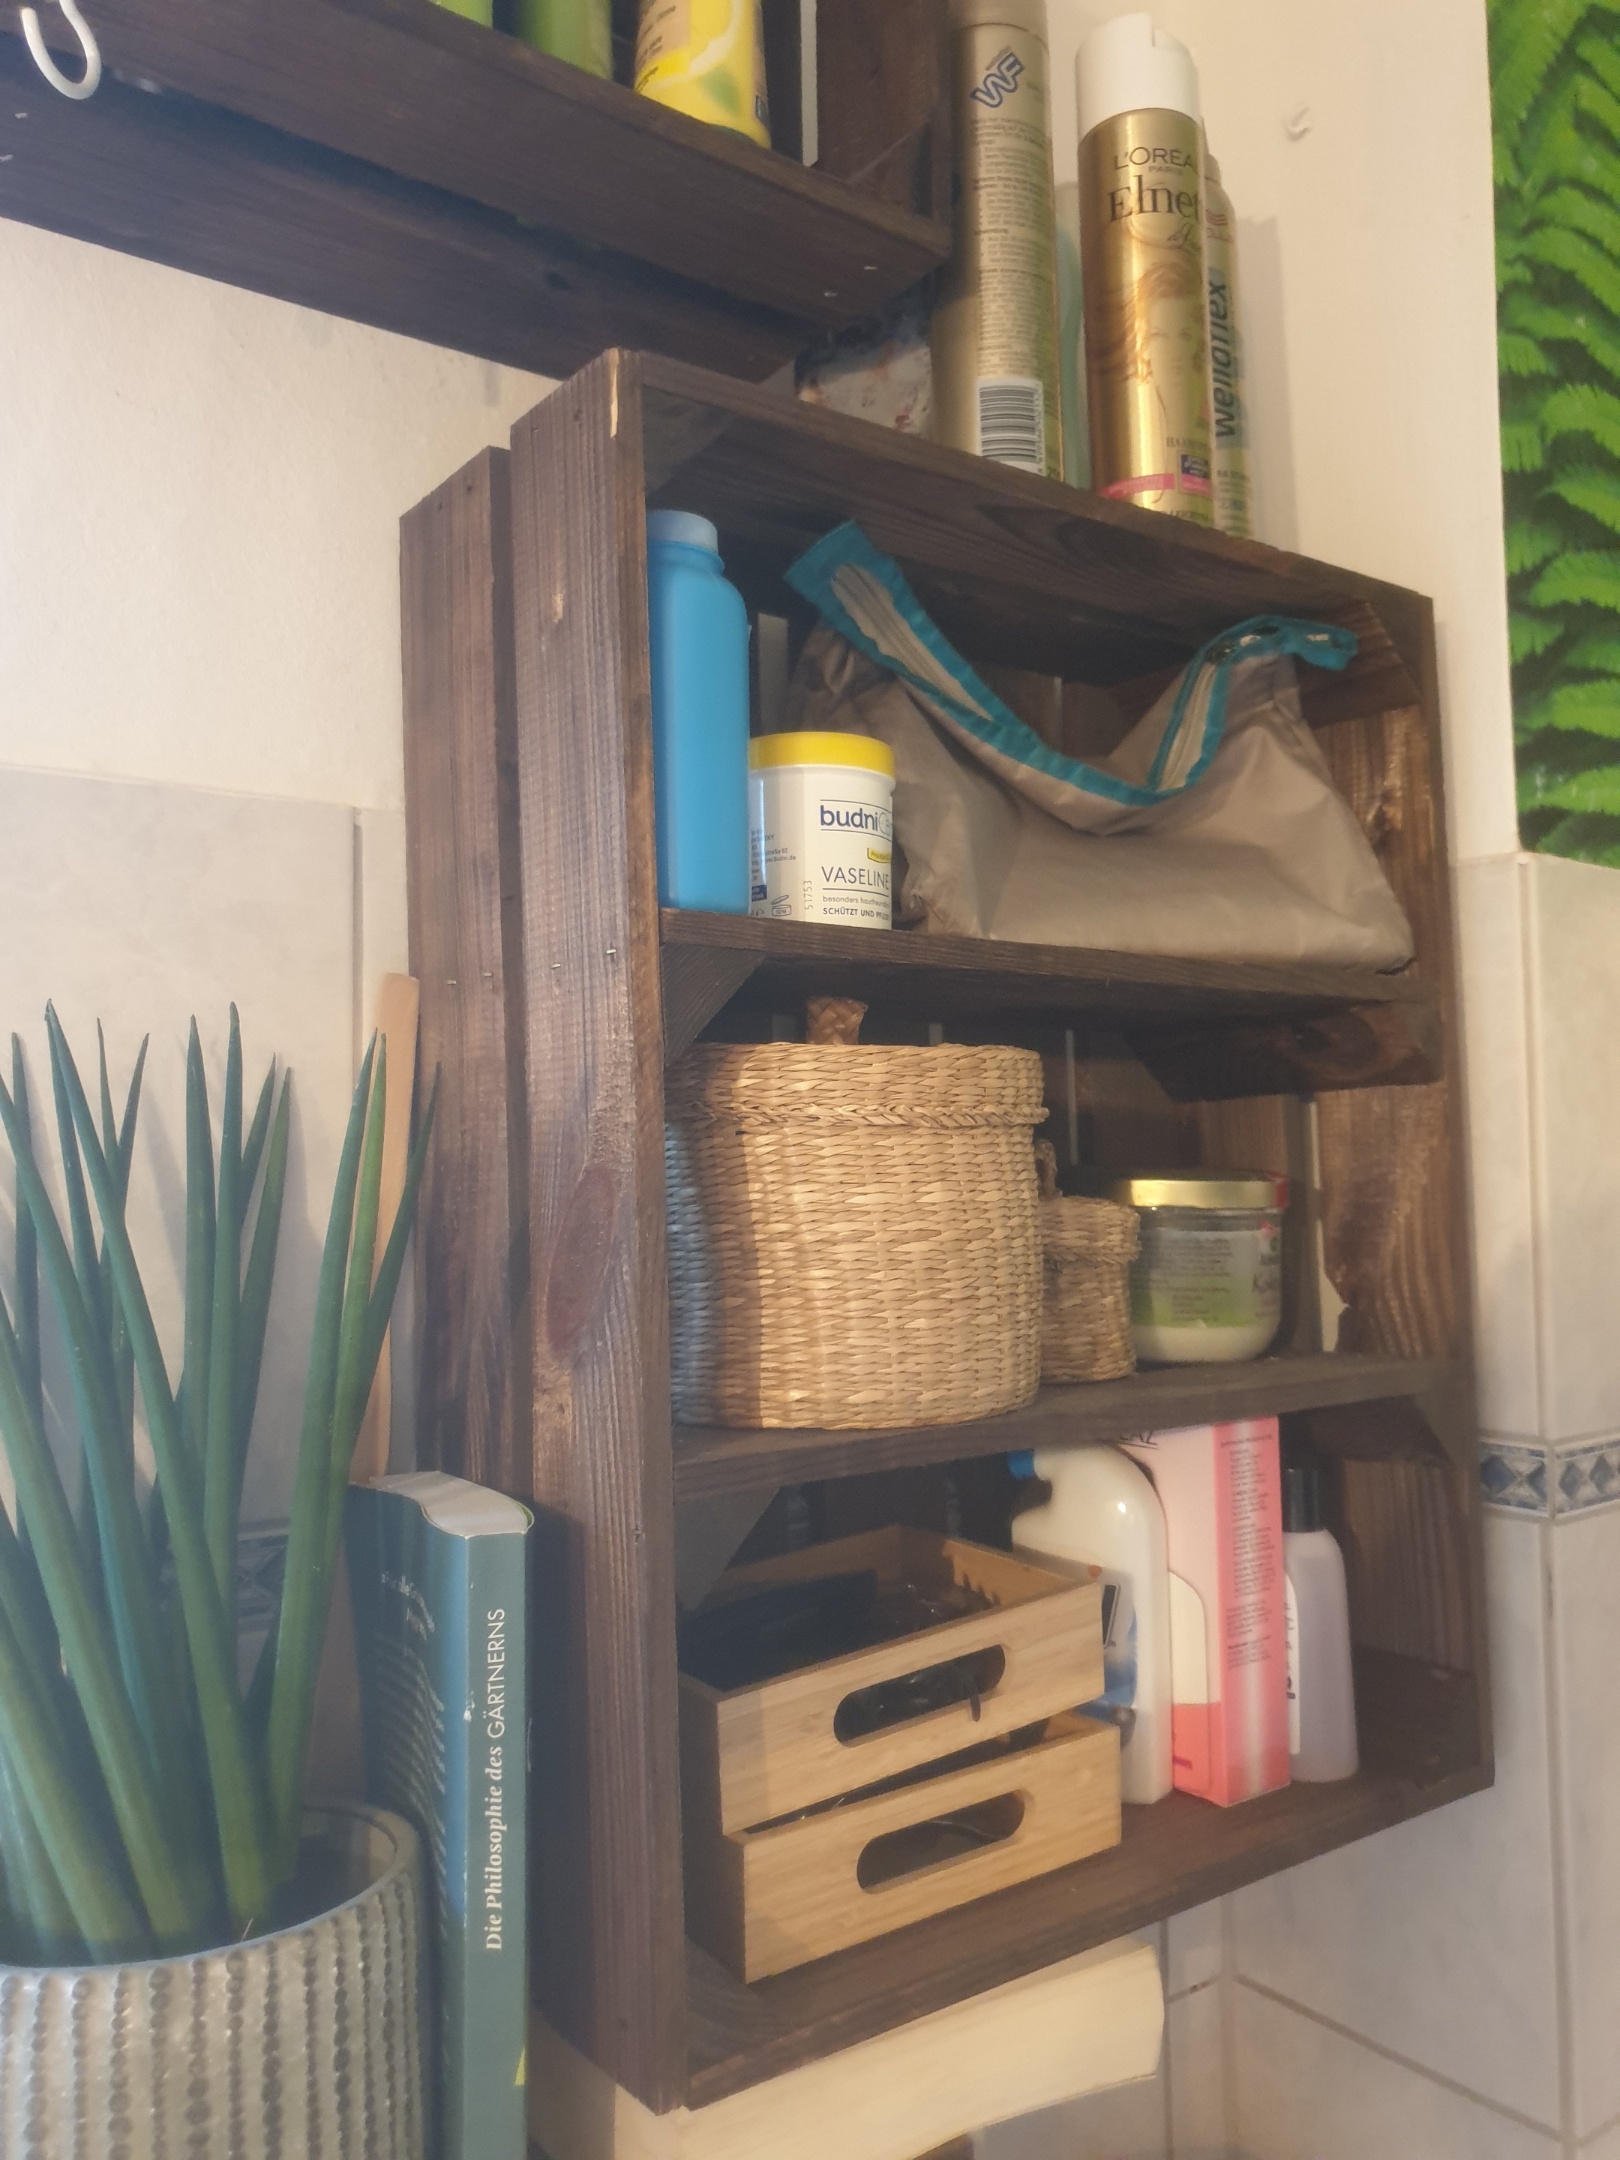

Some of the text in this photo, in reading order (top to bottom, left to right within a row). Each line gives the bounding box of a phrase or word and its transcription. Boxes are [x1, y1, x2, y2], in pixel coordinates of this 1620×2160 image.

[821, 866, 890, 891] VASELINE
[803, 880, 813, 910] 51753
[822, 895, 859, 904] besonders
[822, 906, 859, 916] SCHÜTZT
[860, 909, 875, 918] UND
[482, 1608, 508, 1950] Die Philosophie des GÄRTNERNS
